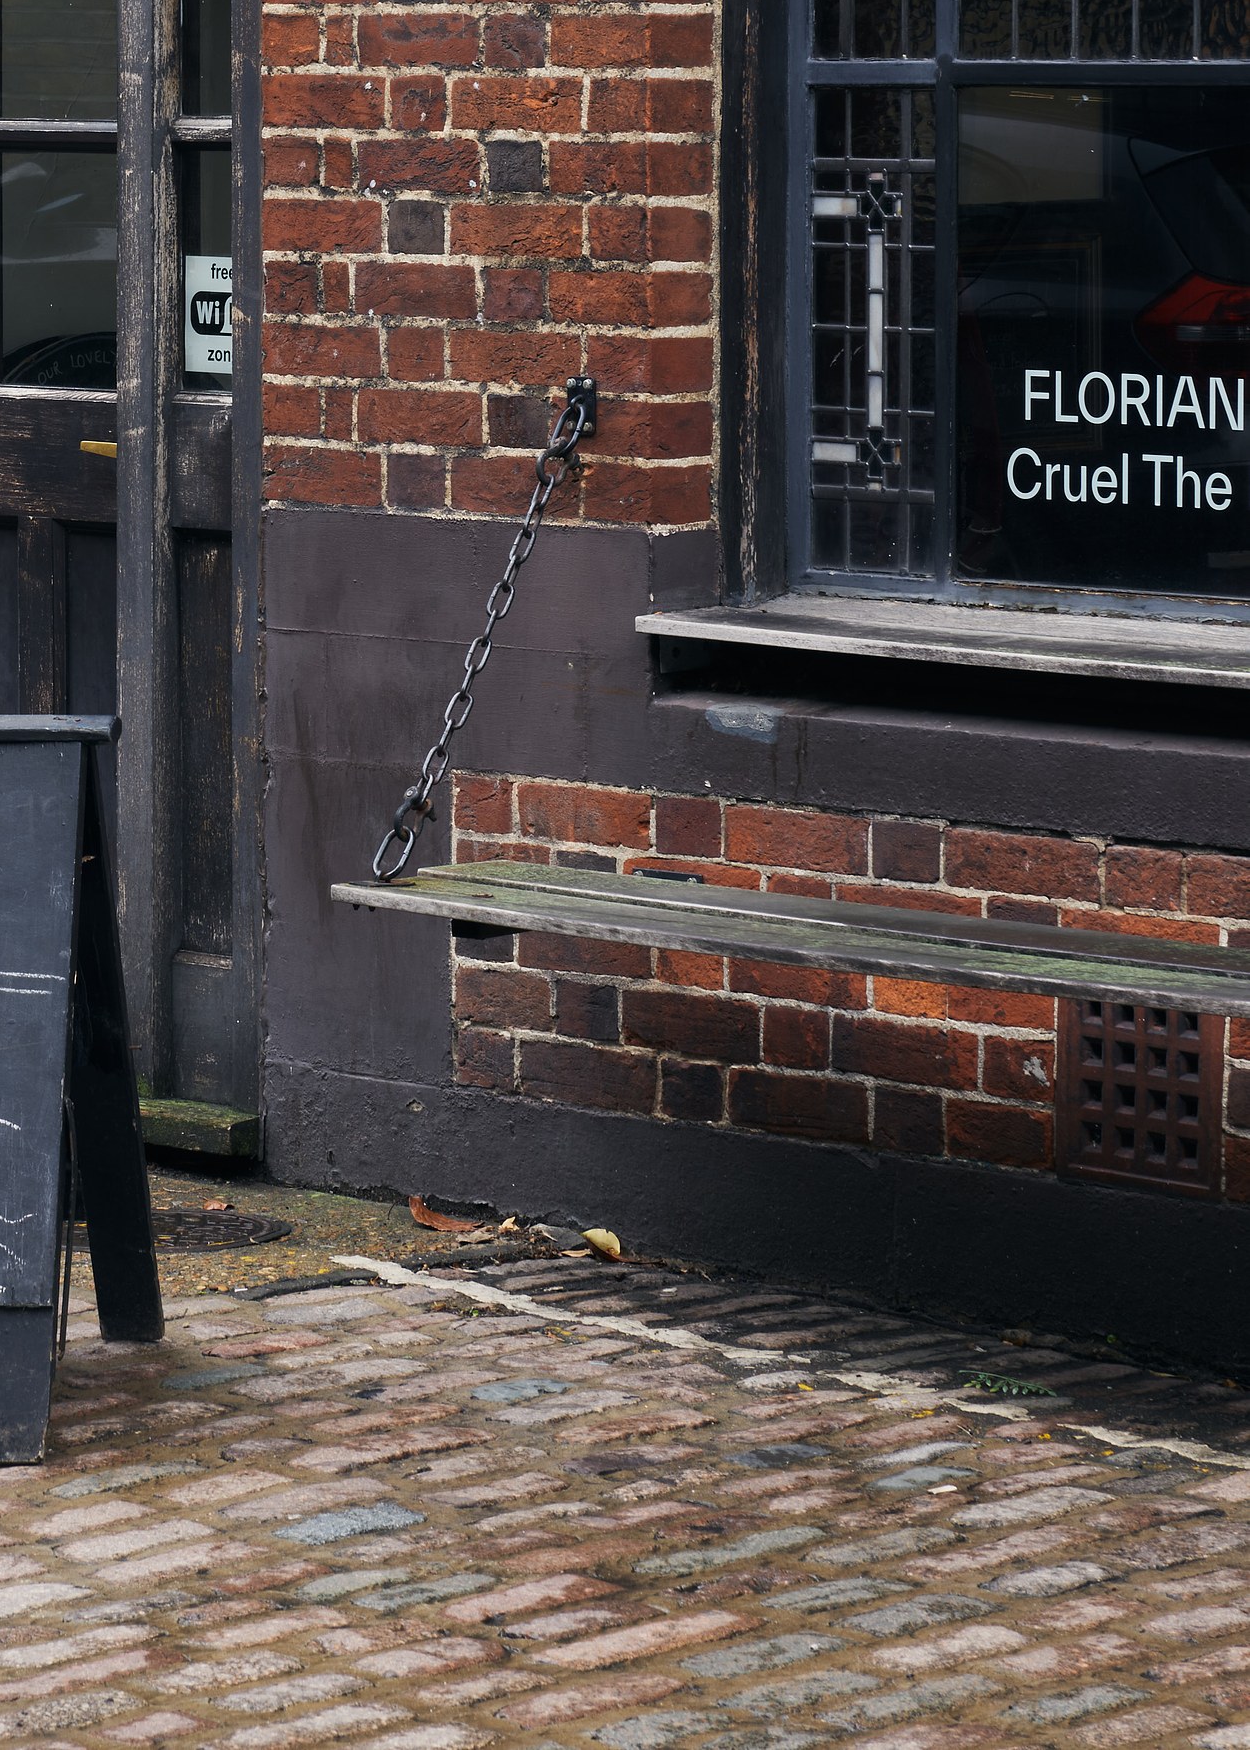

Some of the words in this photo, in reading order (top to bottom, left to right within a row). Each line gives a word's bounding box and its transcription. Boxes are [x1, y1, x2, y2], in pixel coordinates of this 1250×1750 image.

[196, 300, 232, 325] Wi
[207, 349, 231, 362] zon
[37, 360, 63, 386] OUR
[1024, 369, 1245, 431] FLORIAN
[1006, 447, 1129, 505] Cruel
[1142, 453, 1232, 511] The
